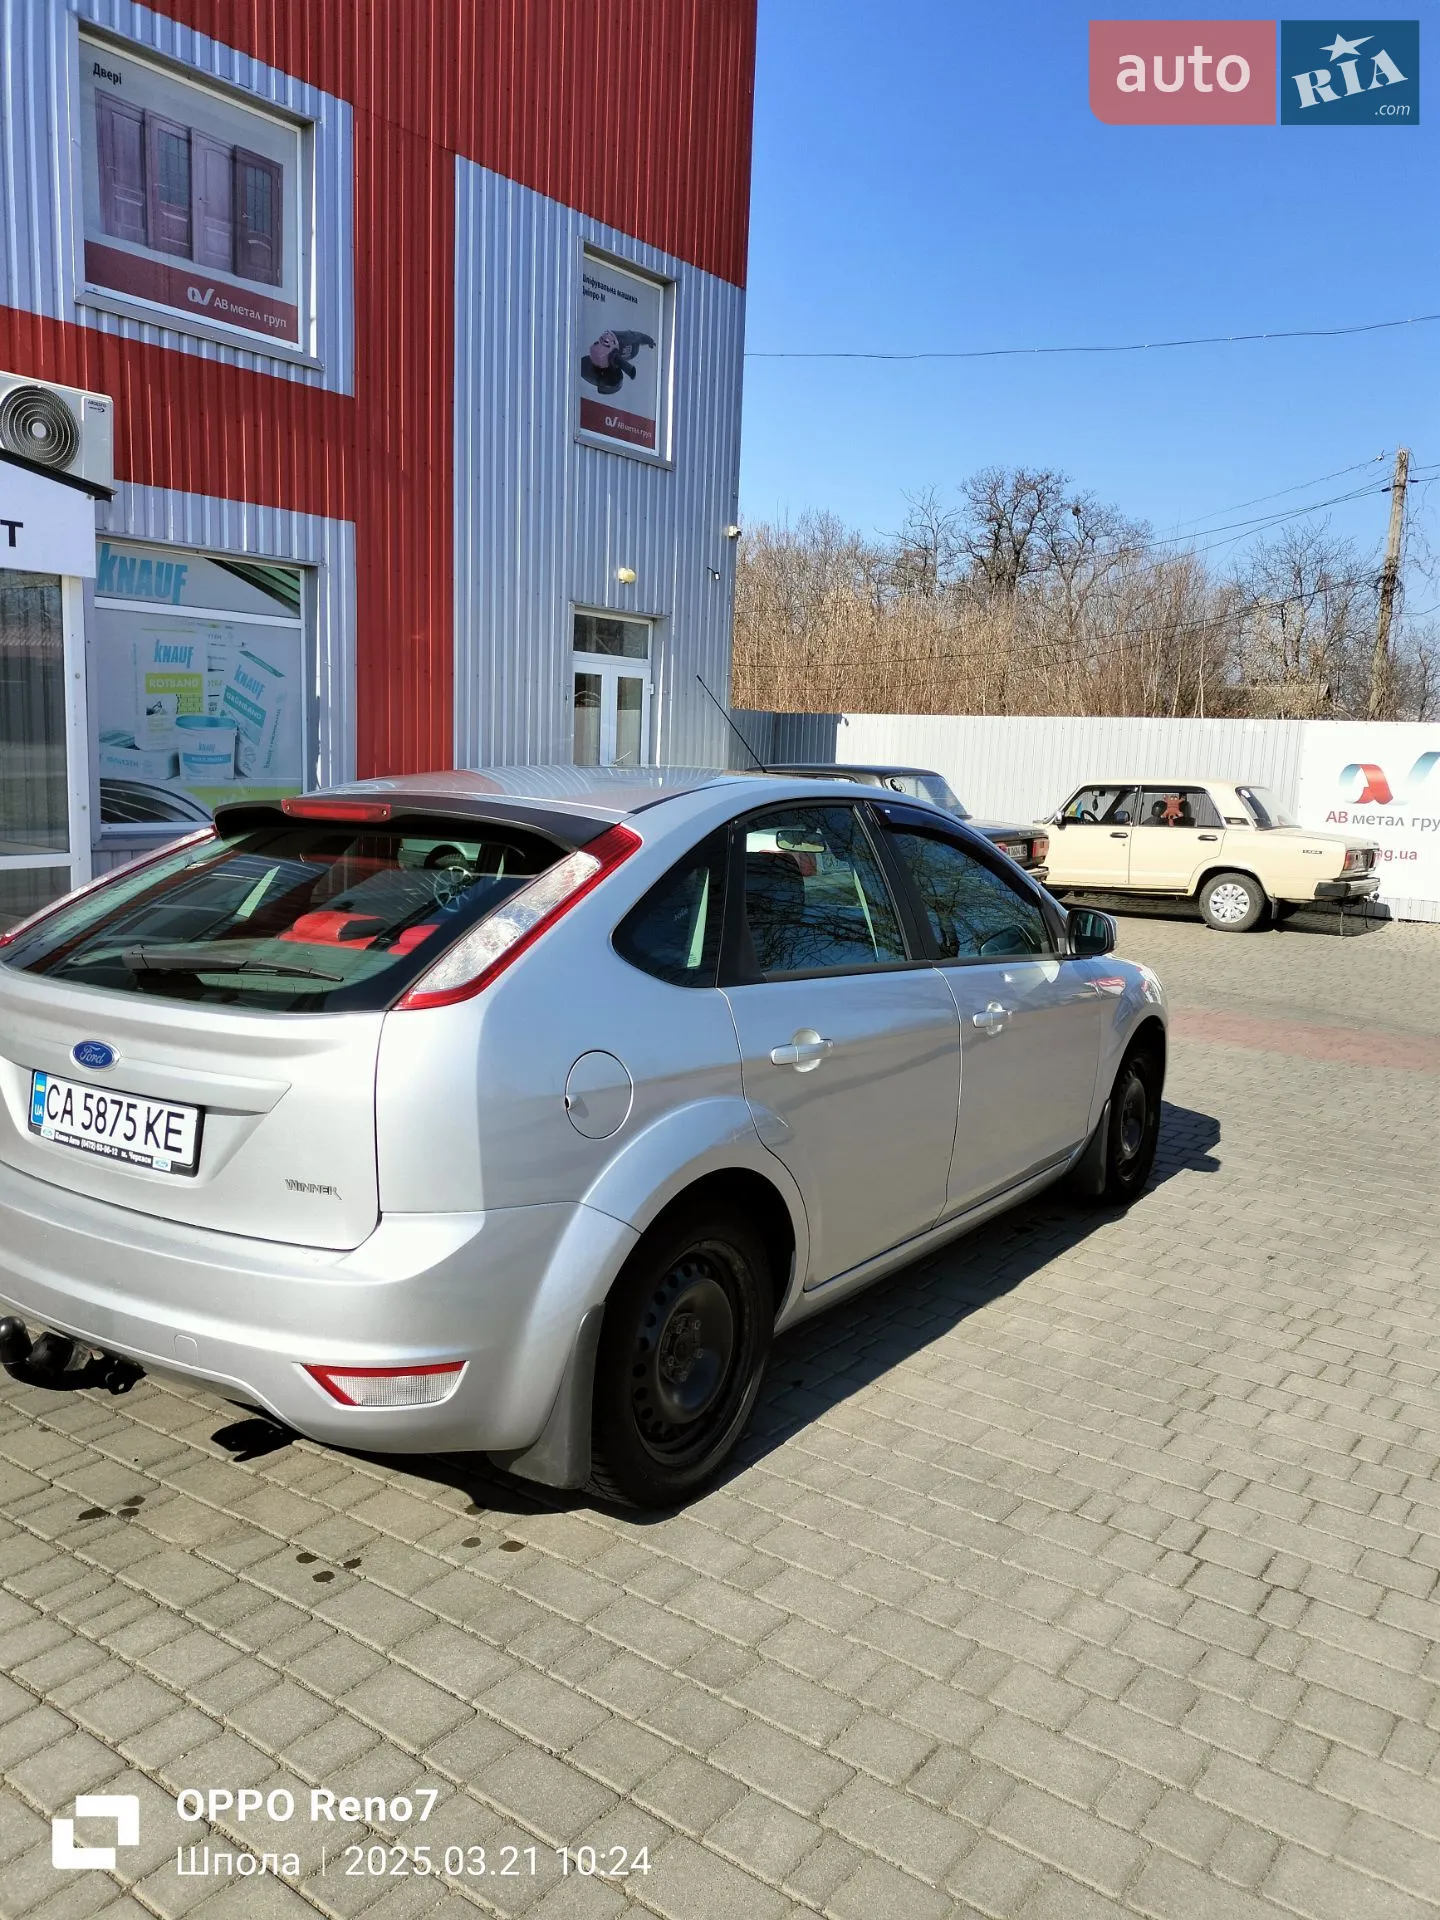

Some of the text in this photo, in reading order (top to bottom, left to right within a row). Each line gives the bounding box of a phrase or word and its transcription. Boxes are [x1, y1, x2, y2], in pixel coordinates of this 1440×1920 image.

[93, 62, 122, 85] Двері
[214, 297, 287, 328] АВ метал груп
[97, 543, 188, 605] KNAUF
[153, 639, 195, 669] KNAUF
[149, 678, 199, 689] ROTBAND
[234, 663, 266, 701] KNAUF
[1325, 810, 1440, 832] АВ метал гру
[79, 1044, 106, 1064] Ford
[34, 1084, 185, 1154] UA CA 5875 KE
[284, 1178, 342, 1201] WINNER
